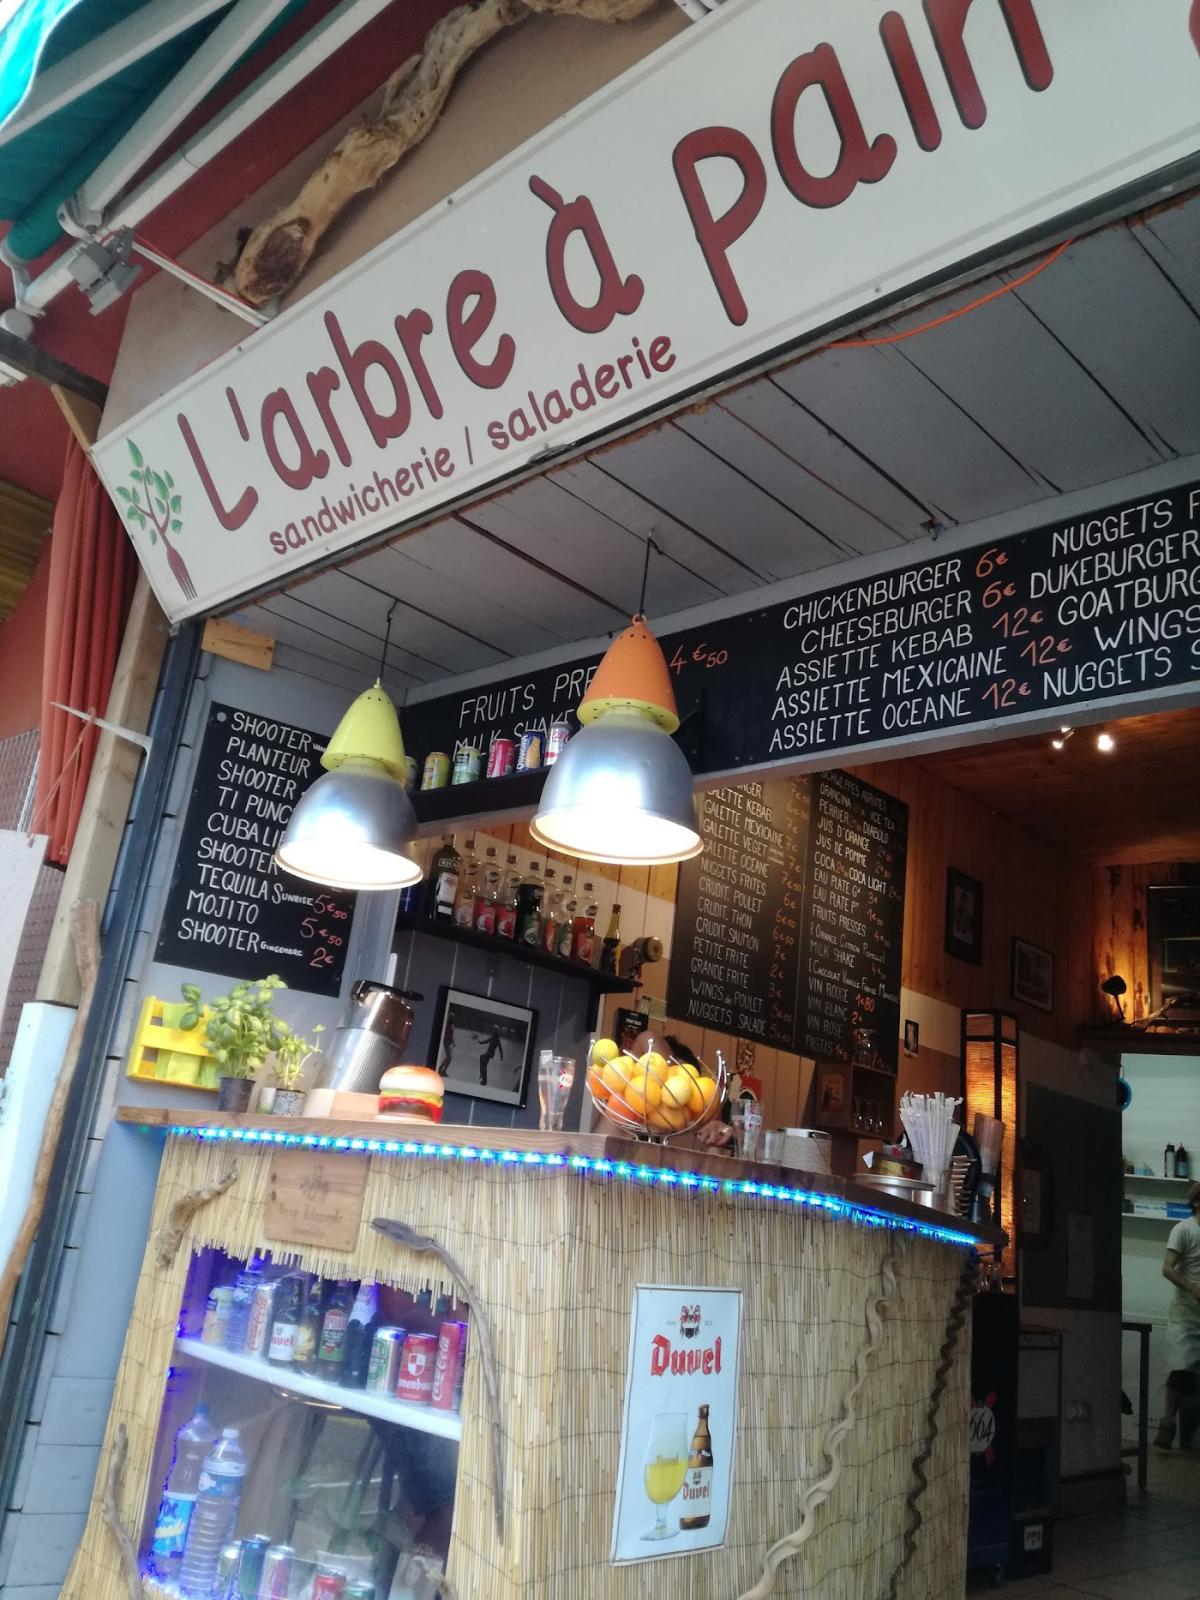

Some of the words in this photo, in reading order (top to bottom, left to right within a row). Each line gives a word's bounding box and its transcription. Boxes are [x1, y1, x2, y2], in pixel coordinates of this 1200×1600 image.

[177, 268, 517, 531] L'arbre
[528, 174, 645, 334] à
[269, 446, 456, 555] sandwicherie
[486, 335, 677, 450] saladerie
[1051, 499, 1173, 558] NUGGETS
[1029, 529, 1200, 599] DUKEBURGER
[784, 559, 962, 630] CHICKENBURGER
[801, 590, 973, 655] CHEESEBURGER
[776, 643, 880, 692] ASSIETTE
[891, 623, 974, 664] KEBAB
[991, 607, 1045, 639] 12€
[770, 676, 871, 722] ASSIETTE
[881, 645, 1008, 699] MEXICAINE
[1018, 635, 1073, 668] 12€
[1042, 645, 1172, 701] NUGGETS
[458, 683, 537, 730] FRUITS
[768, 709, 871, 754] ASSIETTE
[882, 687, 972, 731] OCEANE
[980, 678, 1032, 711] 12€
[230, 711, 312, 753] SHOOTER
[226, 735, 312, 779] PLANTEUR
[217, 759, 297, 801] SHOOTER
[218, 785, 239, 810] TI
[207, 811, 260, 843] CUBA
[703, 799, 742, 829] GALETTE
[746, 798, 773, 823] KEBAB
[817, 815, 835, 835] JUS
[702, 818, 740, 847] GALETTE
[815, 833, 833, 852] JUS
[833, 840, 844, 857] DE
[844, 845, 869, 869] POMME
[197, 836, 279, 876] SHOOTER
[702, 837, 739, 865] GALETTE
[740, 853, 770, 879] OCEANE
[814, 850, 836, 872] COCA
[197, 862, 269, 902] TEQUILA
[699, 856, 738, 886] NUGGETS
[740, 872, 767, 897] FRITES
[814, 867, 829, 885] EAU
[830, 874, 851, 896] PLATE
[848, 866, 867, 887] COCA
[867, 874, 888, 895] LIGHT
[185, 888, 260, 926] MOJITO
[733, 889, 763, 914] POULET
[812, 884, 828, 903] EAU
[829, 891, 850, 914] PLATE
[732, 908, 753, 931] THON
[812, 903, 837, 927] FRUITS
[838, 914, 868, 938] PRESSES
[177, 917, 261, 955] SHOOTER
[308, 946, 336, 970] 2€
[693, 936, 725, 961] PETITE
[725, 946, 749, 970] FRITE
[727, 927, 760, 953] SAUMON
[833, 947, 857, 969] SHAKE
[690, 956, 726, 982] GRANDE
[726, 968, 750, 990] FRITE
[807, 976, 824, 994] VIN
[690, 976, 724, 1001] WINGS
[733, 990, 765, 1014] POULET
[687, 998, 733, 1027] NUGGETS
[737, 1012, 767, 1037] SALADE
[650, 1333, 722, 1377] Duvel
[682, 1481, 711, 1501] Duvel
